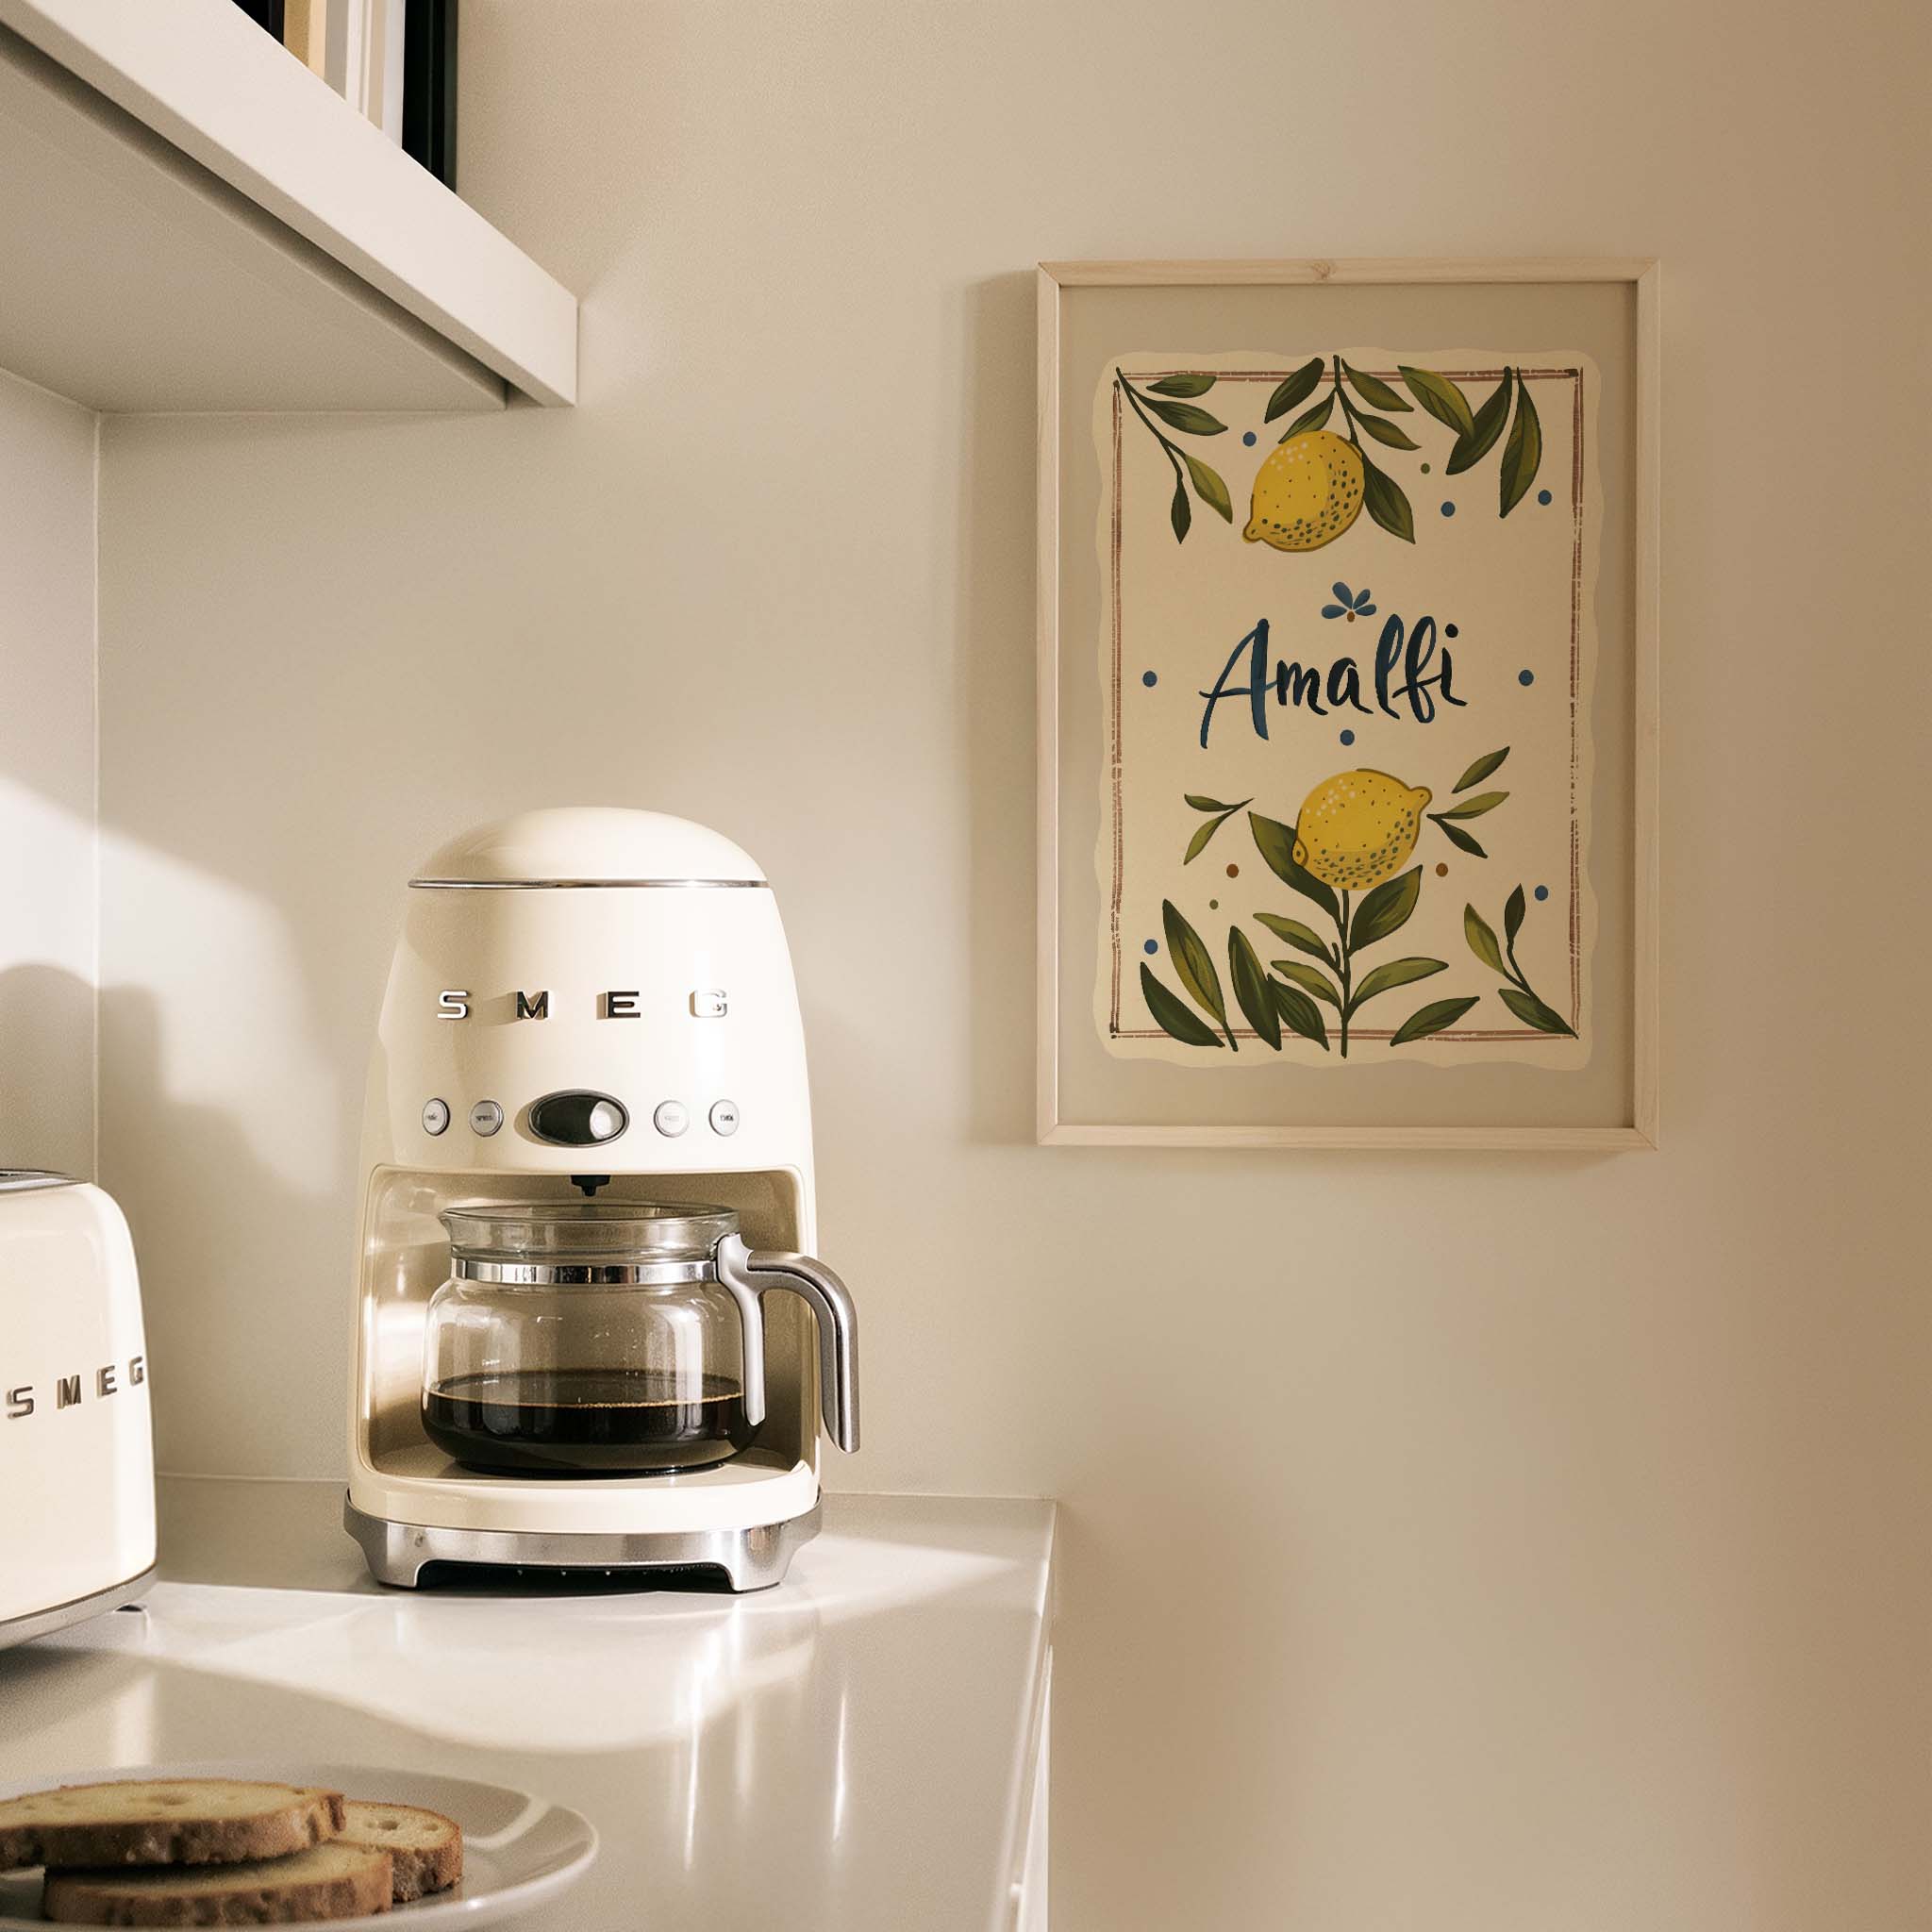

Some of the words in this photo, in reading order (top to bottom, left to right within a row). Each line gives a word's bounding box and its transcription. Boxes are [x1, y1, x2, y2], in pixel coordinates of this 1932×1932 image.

[1199, 613, 1468, 750] Amalfi
[437, 990, 728, 1020] SMEG
[6, 1356, 144, 1420] SMEG
